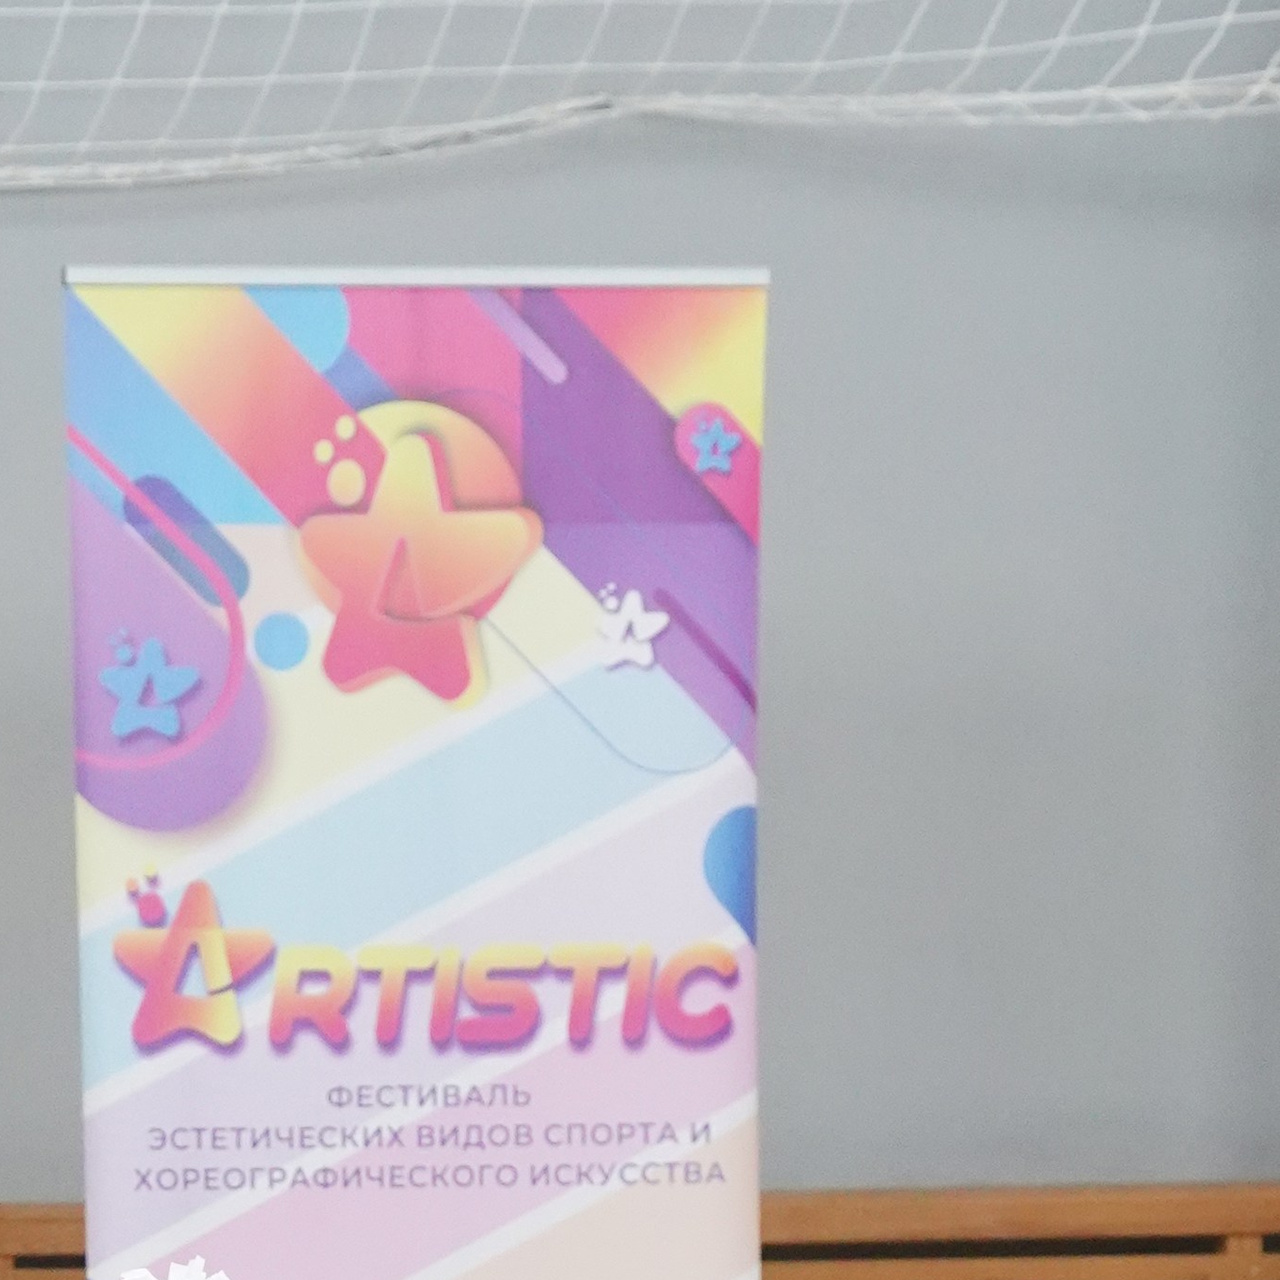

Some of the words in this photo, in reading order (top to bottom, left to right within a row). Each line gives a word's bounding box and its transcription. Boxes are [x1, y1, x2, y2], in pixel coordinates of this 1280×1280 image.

[113, 880, 740, 1055] ARTISTIC
[327, 1084, 531, 1109] ФЕСТИВАЛЬ
[148, 1126, 406, 1151] ЭСТЕТИЧЕСКИХ
[419, 1124, 534, 1150] ВИДОВ
[545, 1123, 680, 1147] СПОРТА
[690, 1123, 712, 1146] И
[135, 1164, 519, 1192] ХОРЕОГРАФИЧЕСКОГО
[529, 1162, 726, 1188] ИСКУССТВА
